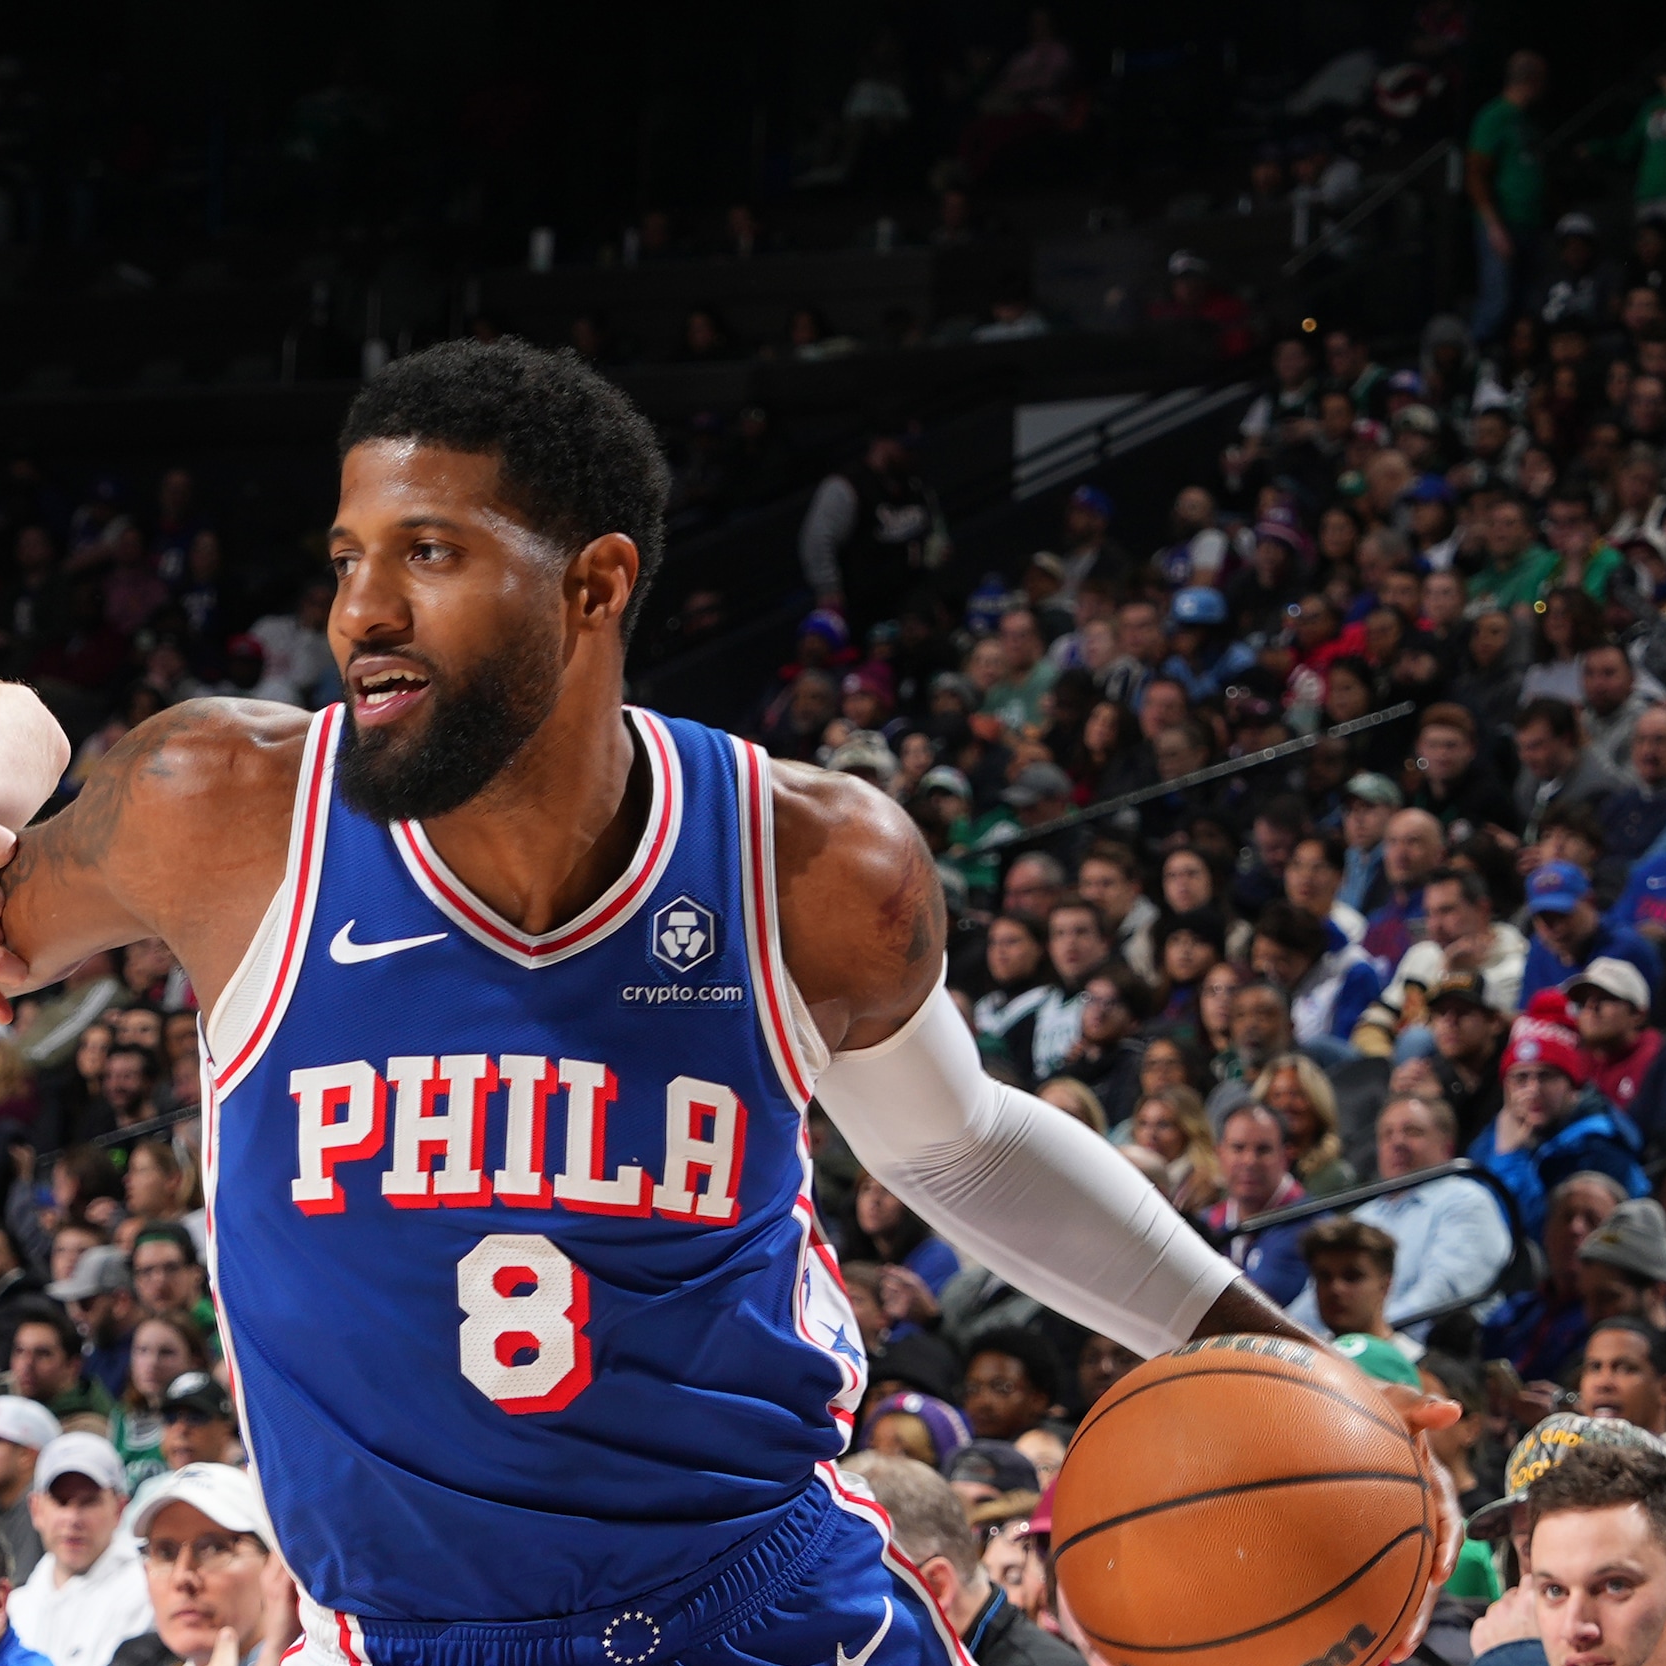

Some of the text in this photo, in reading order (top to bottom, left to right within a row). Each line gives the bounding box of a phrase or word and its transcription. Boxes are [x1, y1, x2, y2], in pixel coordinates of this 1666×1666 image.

[621, 980, 744, 1006] crypto.com
[287, 1052, 750, 1227] PHILA
[456, 1232, 593, 1417] 8
